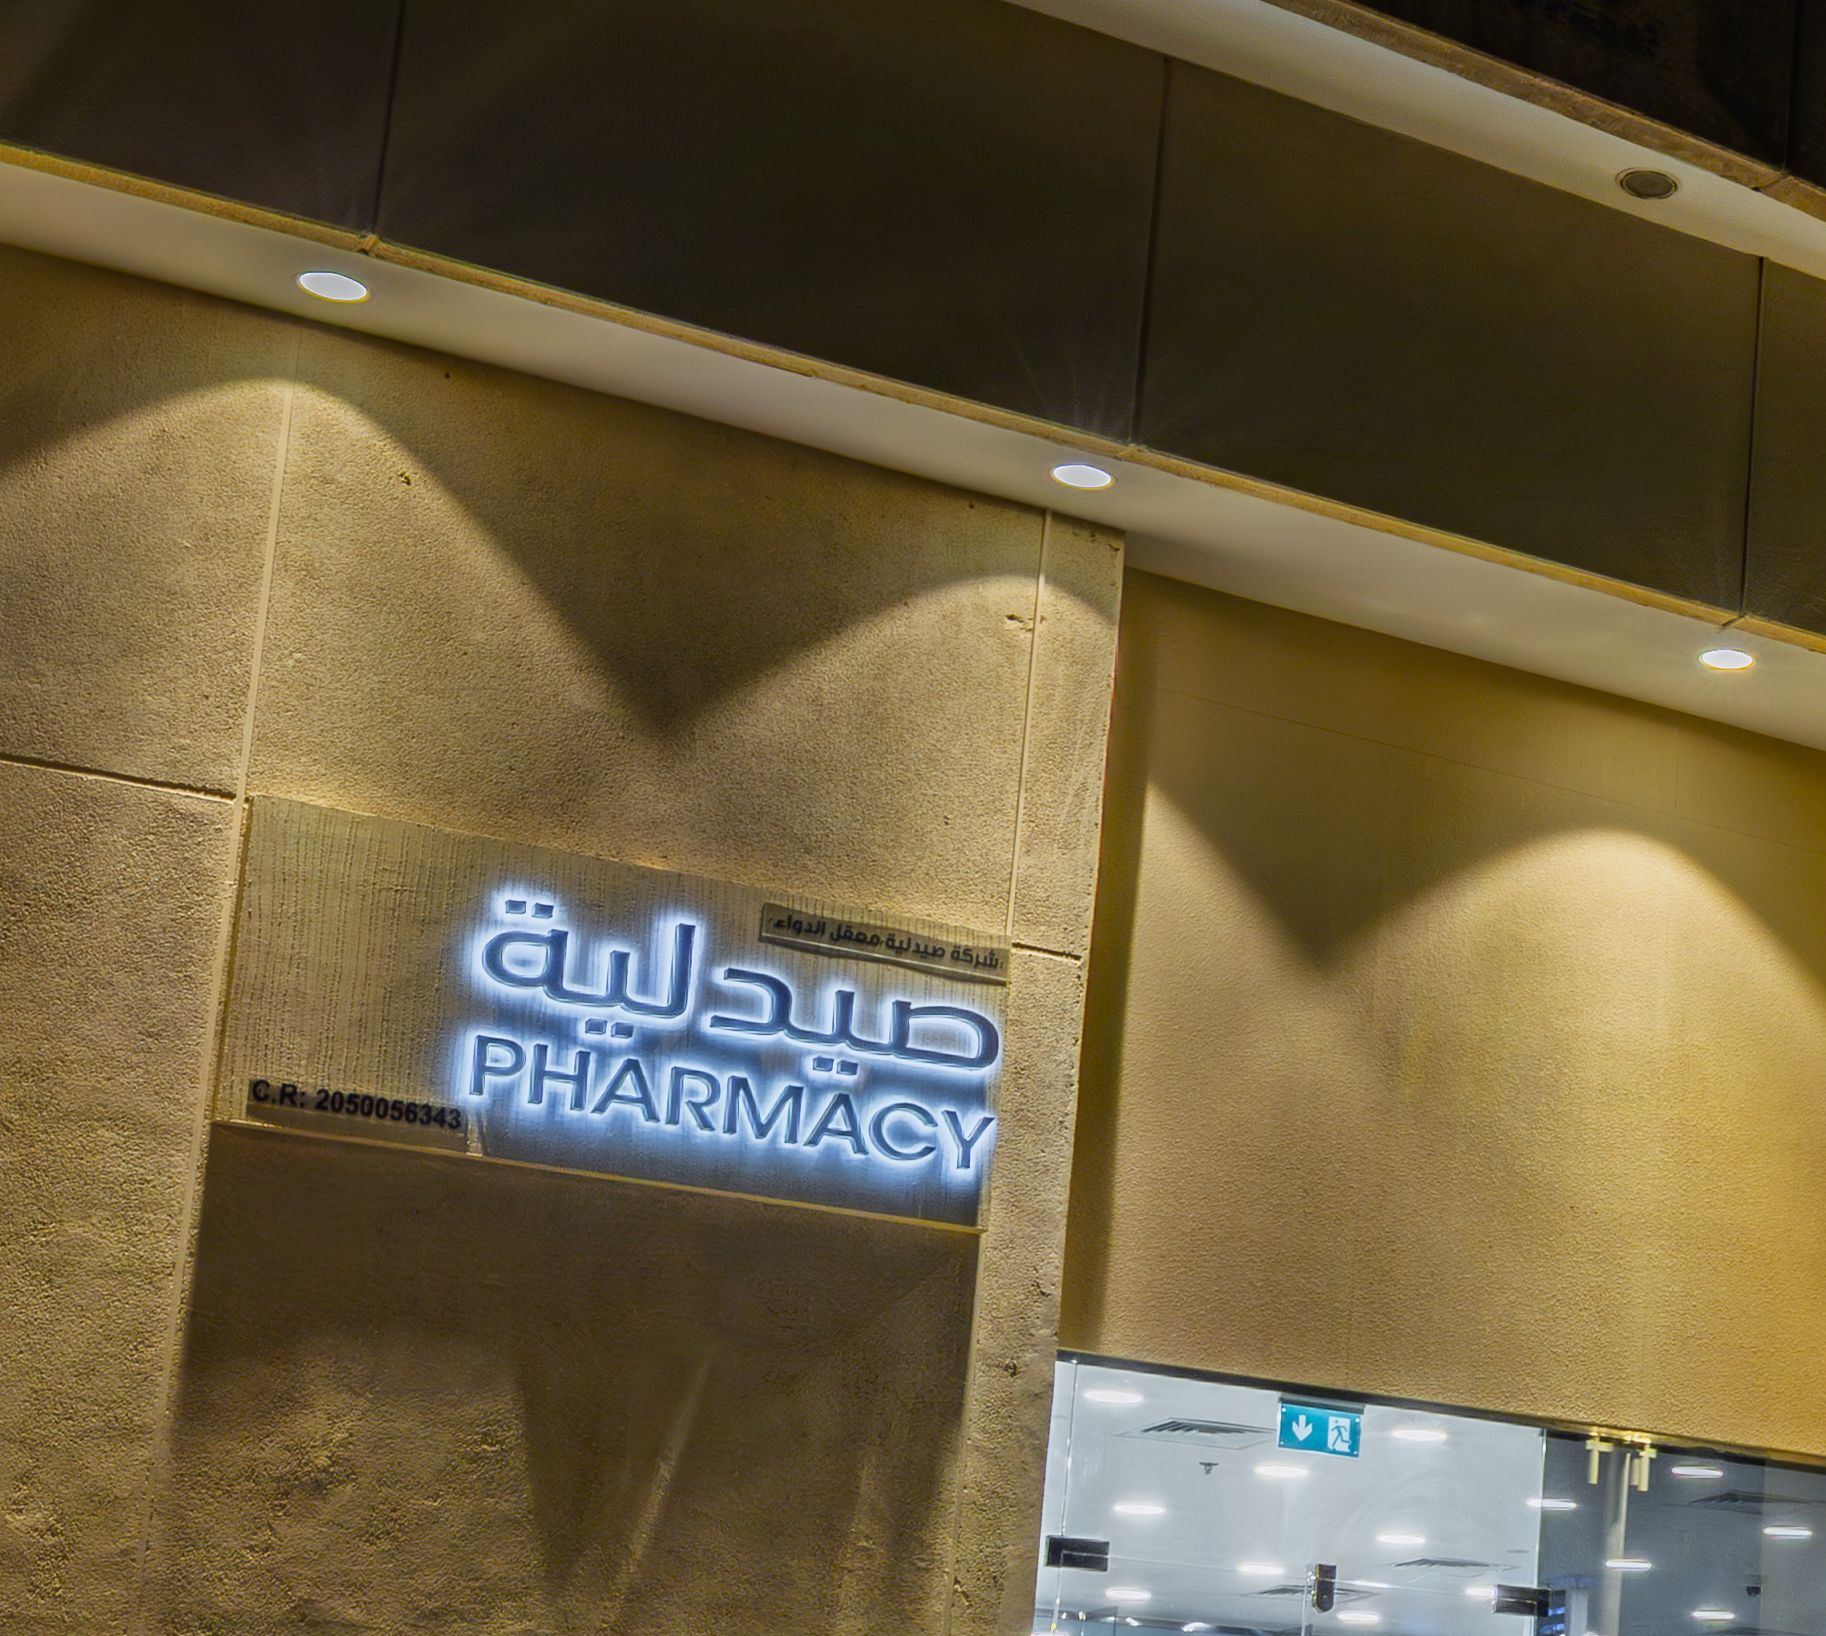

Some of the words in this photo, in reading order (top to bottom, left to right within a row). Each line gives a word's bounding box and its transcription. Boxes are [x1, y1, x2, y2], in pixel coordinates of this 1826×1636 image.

[772, 914, 826, 936] الدواء
[885, 932, 946, 959] صيدلية
[950, 945, 999, 969] شركة
[482, 899, 999, 1075] صيدلية
[252, 1079, 306, 1108] C.R:
[315, 1088, 462, 1130] 2050056343
[469, 1034, 995, 1170] PHARMACY
